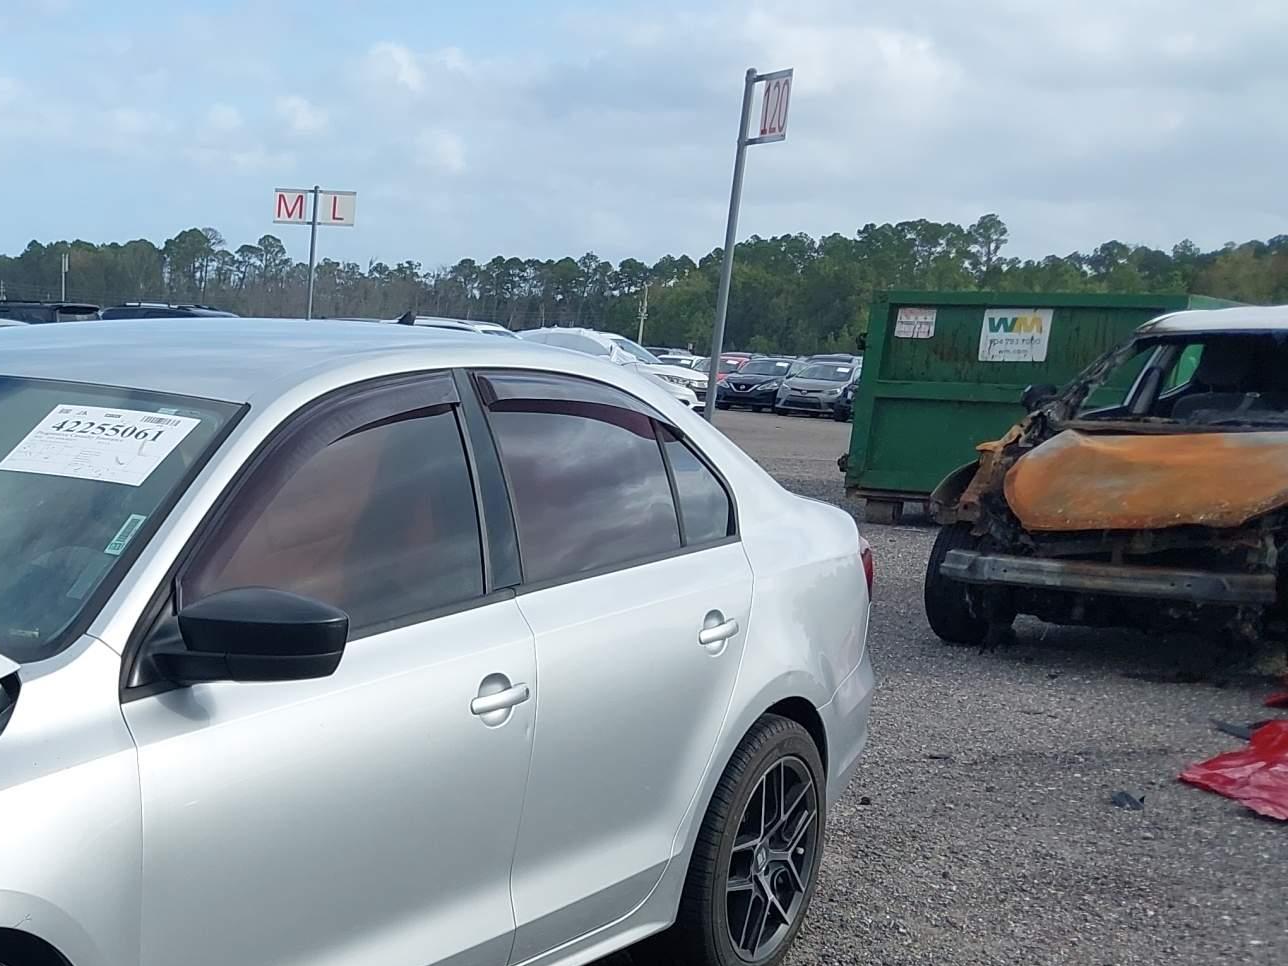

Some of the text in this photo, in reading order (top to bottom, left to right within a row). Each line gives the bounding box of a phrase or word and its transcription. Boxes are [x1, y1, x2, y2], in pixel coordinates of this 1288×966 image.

[760, 78, 791, 135] 120
[276, 193, 304, 219] M
[332, 195, 345, 221] L
[988, 314, 1043, 335] WM
[51, 419, 166, 443] 42255061
